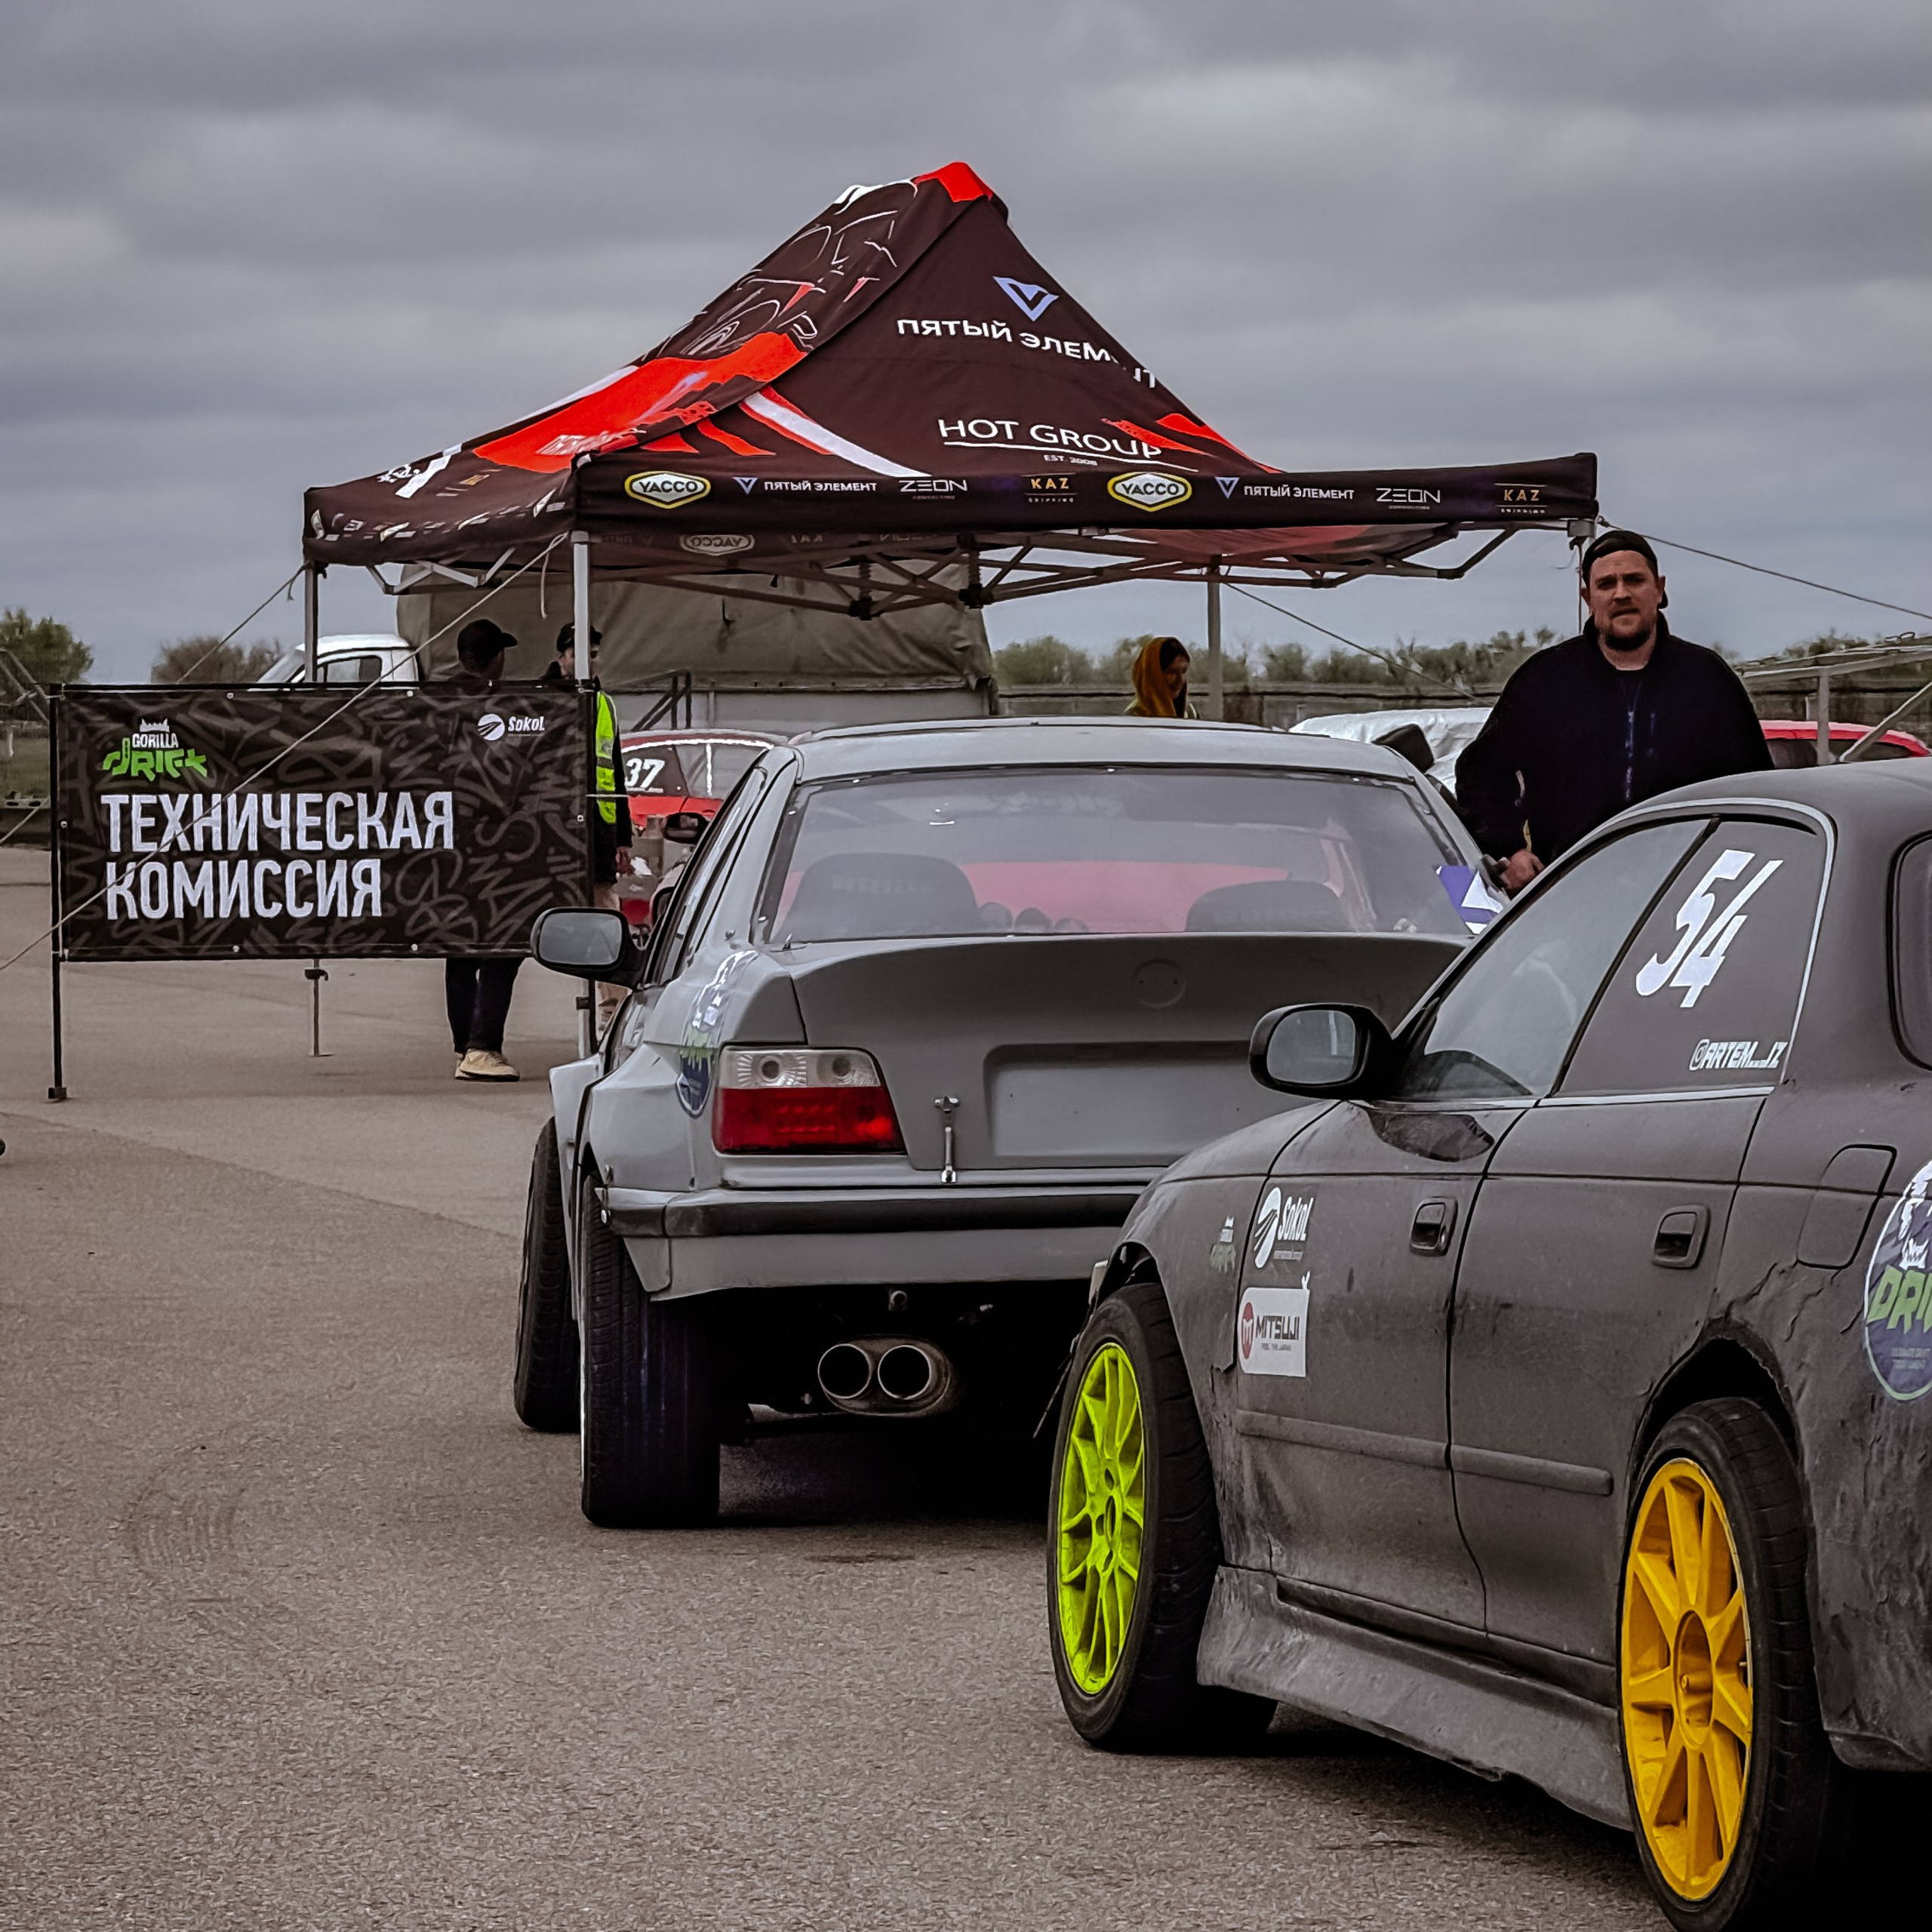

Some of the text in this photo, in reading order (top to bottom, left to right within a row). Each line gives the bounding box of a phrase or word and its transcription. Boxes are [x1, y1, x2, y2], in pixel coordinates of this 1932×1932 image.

[897, 319, 1013, 343] ПЯТЫЙ
[938, 418, 1020, 440] HOT
[639, 480, 698, 493] YACCO
[764, 480, 877, 491] ПЯТЫЙ ЭЛЕМЕНТ
[899, 479, 968, 493] ZEON
[1031, 477, 1069, 490] KAZ
[1121, 482, 1180, 496] YACCO
[1244, 484, 1355, 500] ПЯТЫЙ ЭЛЕМЕНТ
[1376, 488, 1441, 503] ZEON
[1504, 489, 1540, 502] KAZ
[132, 732, 180, 749] GORILLA
[625, 758, 666, 788] 37
[100, 791, 454, 853] ТЕХНИЧЕСКАЯ
[106, 858, 383, 920] КОМИССИЯ
[1635, 849, 1784, 1008] 54
[1255, 1315, 1300, 1340] MITSUJI
